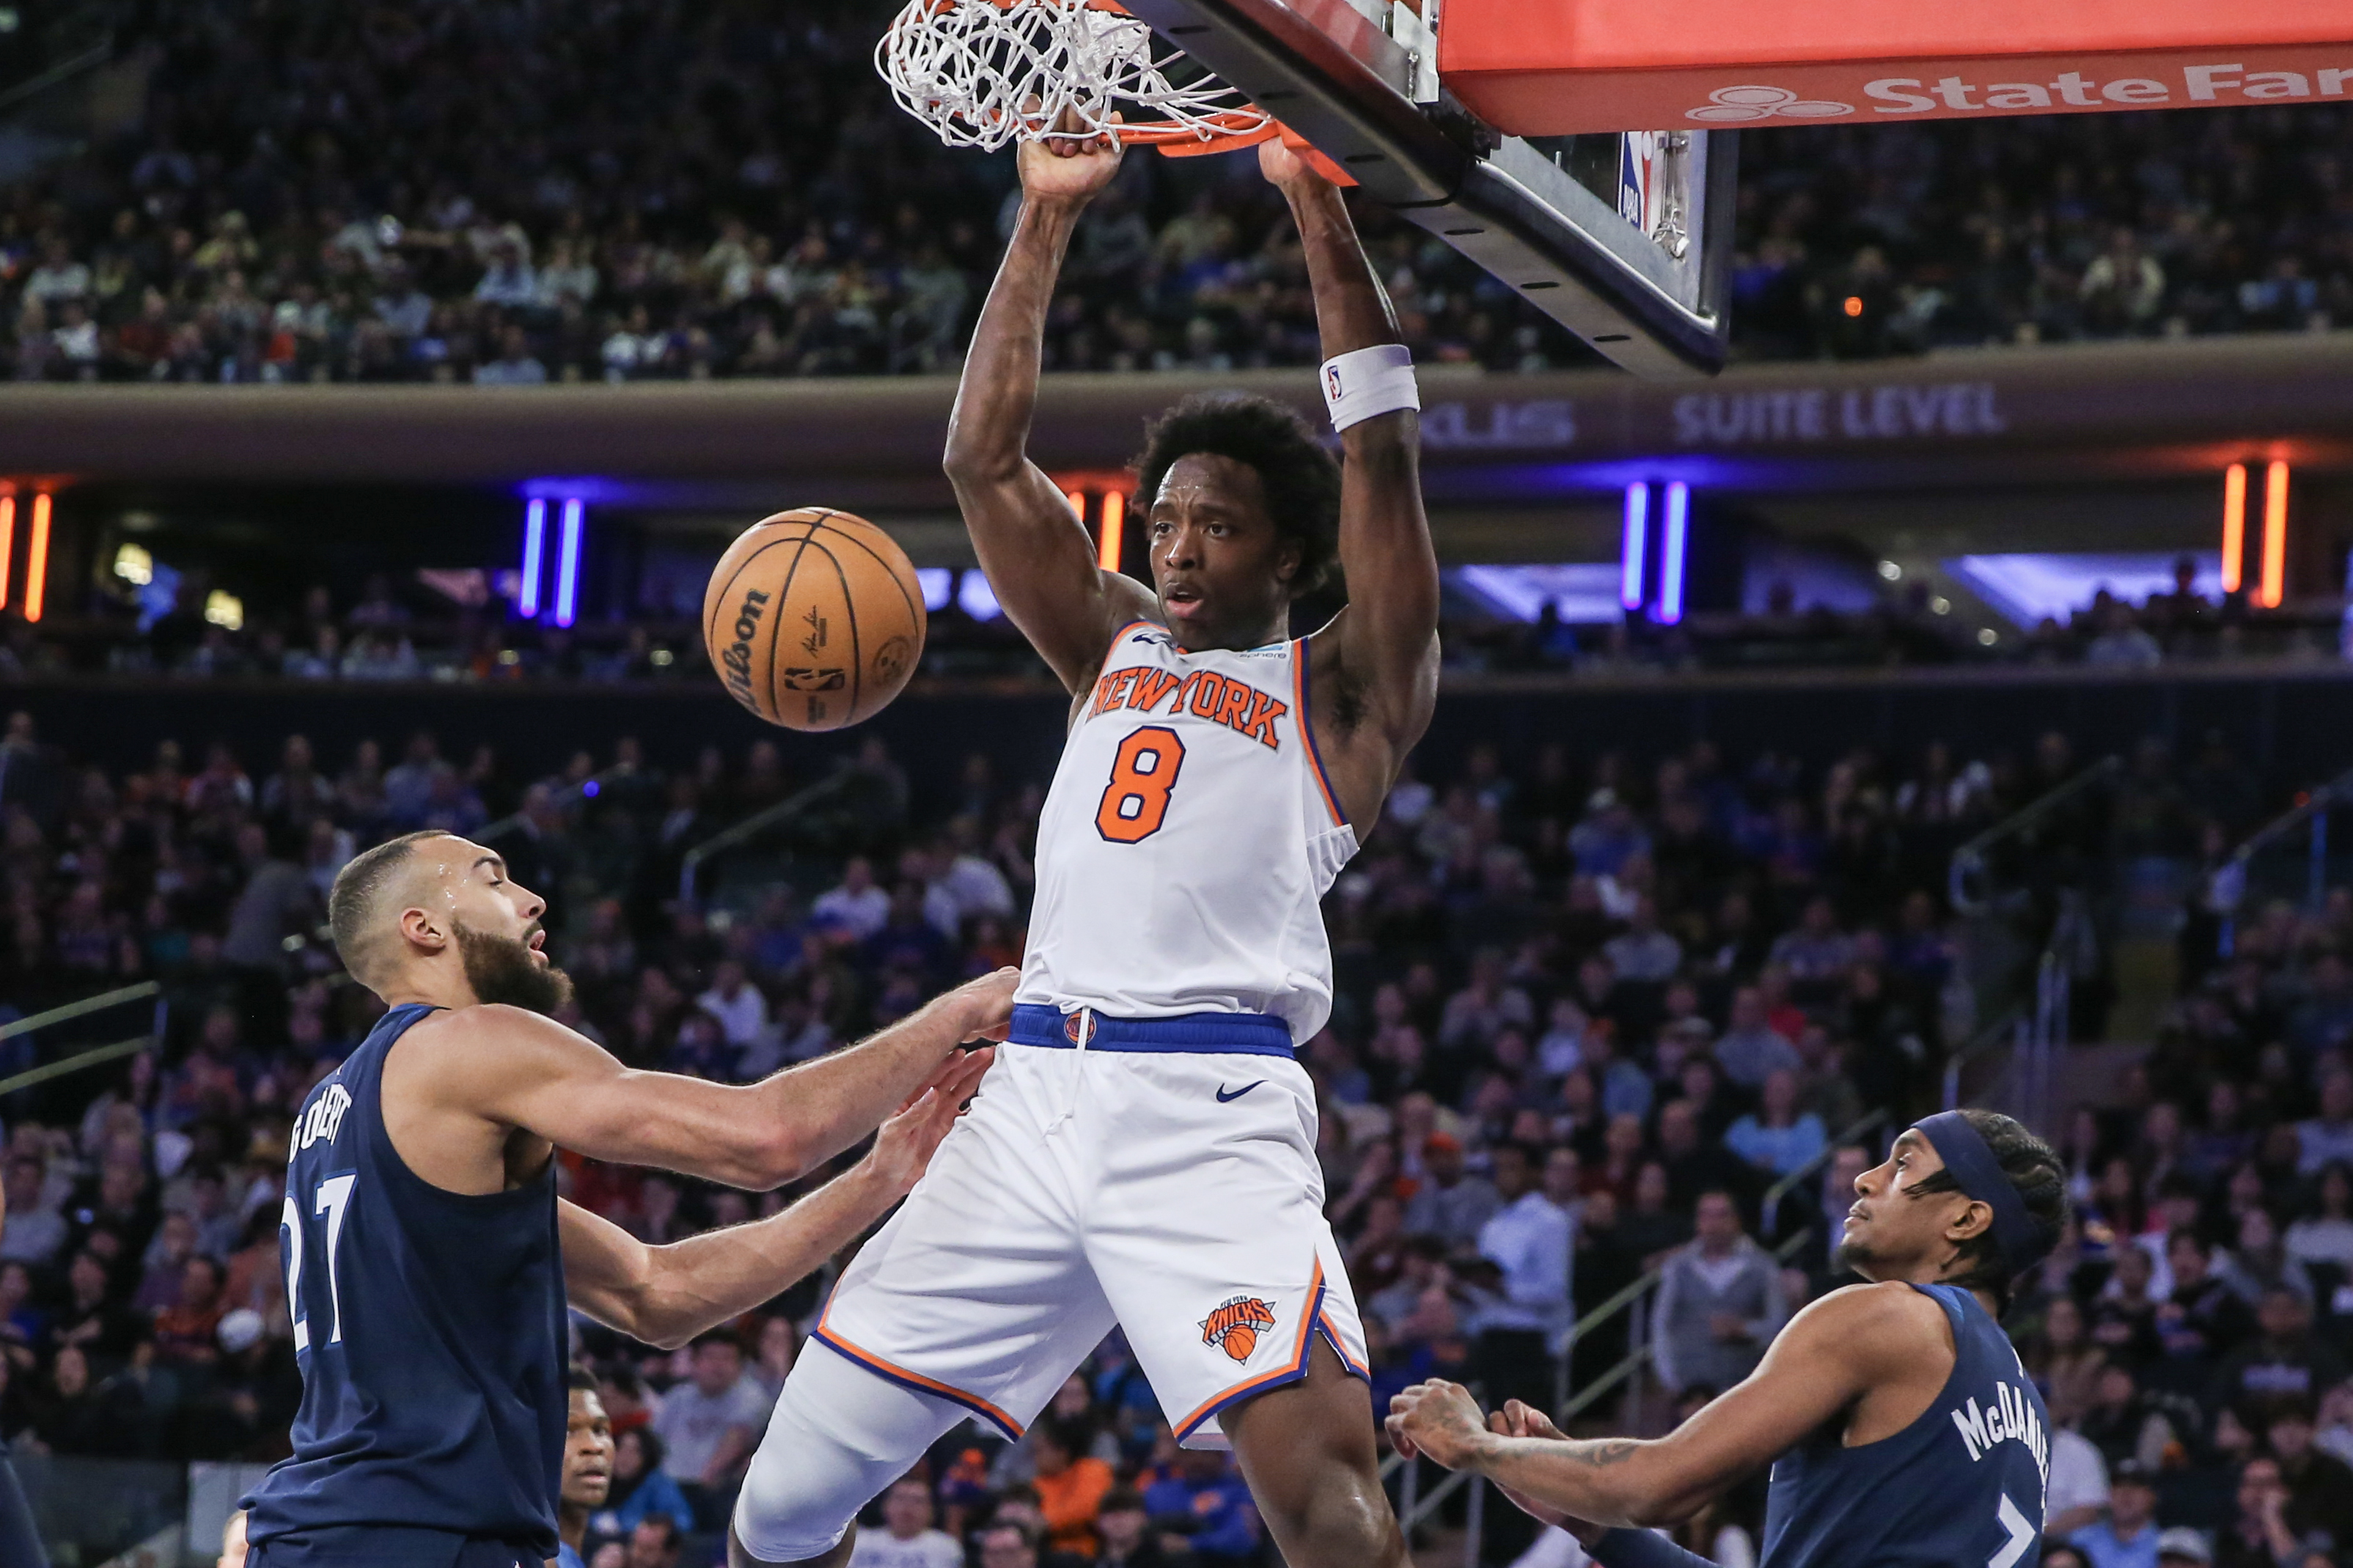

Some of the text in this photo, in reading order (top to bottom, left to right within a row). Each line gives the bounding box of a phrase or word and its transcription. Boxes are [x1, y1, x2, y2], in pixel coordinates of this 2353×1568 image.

[1862, 71, 2169, 114] State
[1623, 183, 1639, 223] NBA
[1672, 383, 2007, 442] SUITE LEVEL
[722, 588, 771, 715] Wilson
[1084, 666, 1291, 754] NEW YORK
[1094, 725, 1186, 844] 8
[288, 1083, 353, 1164] GOERT
[281, 1173, 357, 1352] 27
[1203, 1298, 1276, 1343] KNICKS
